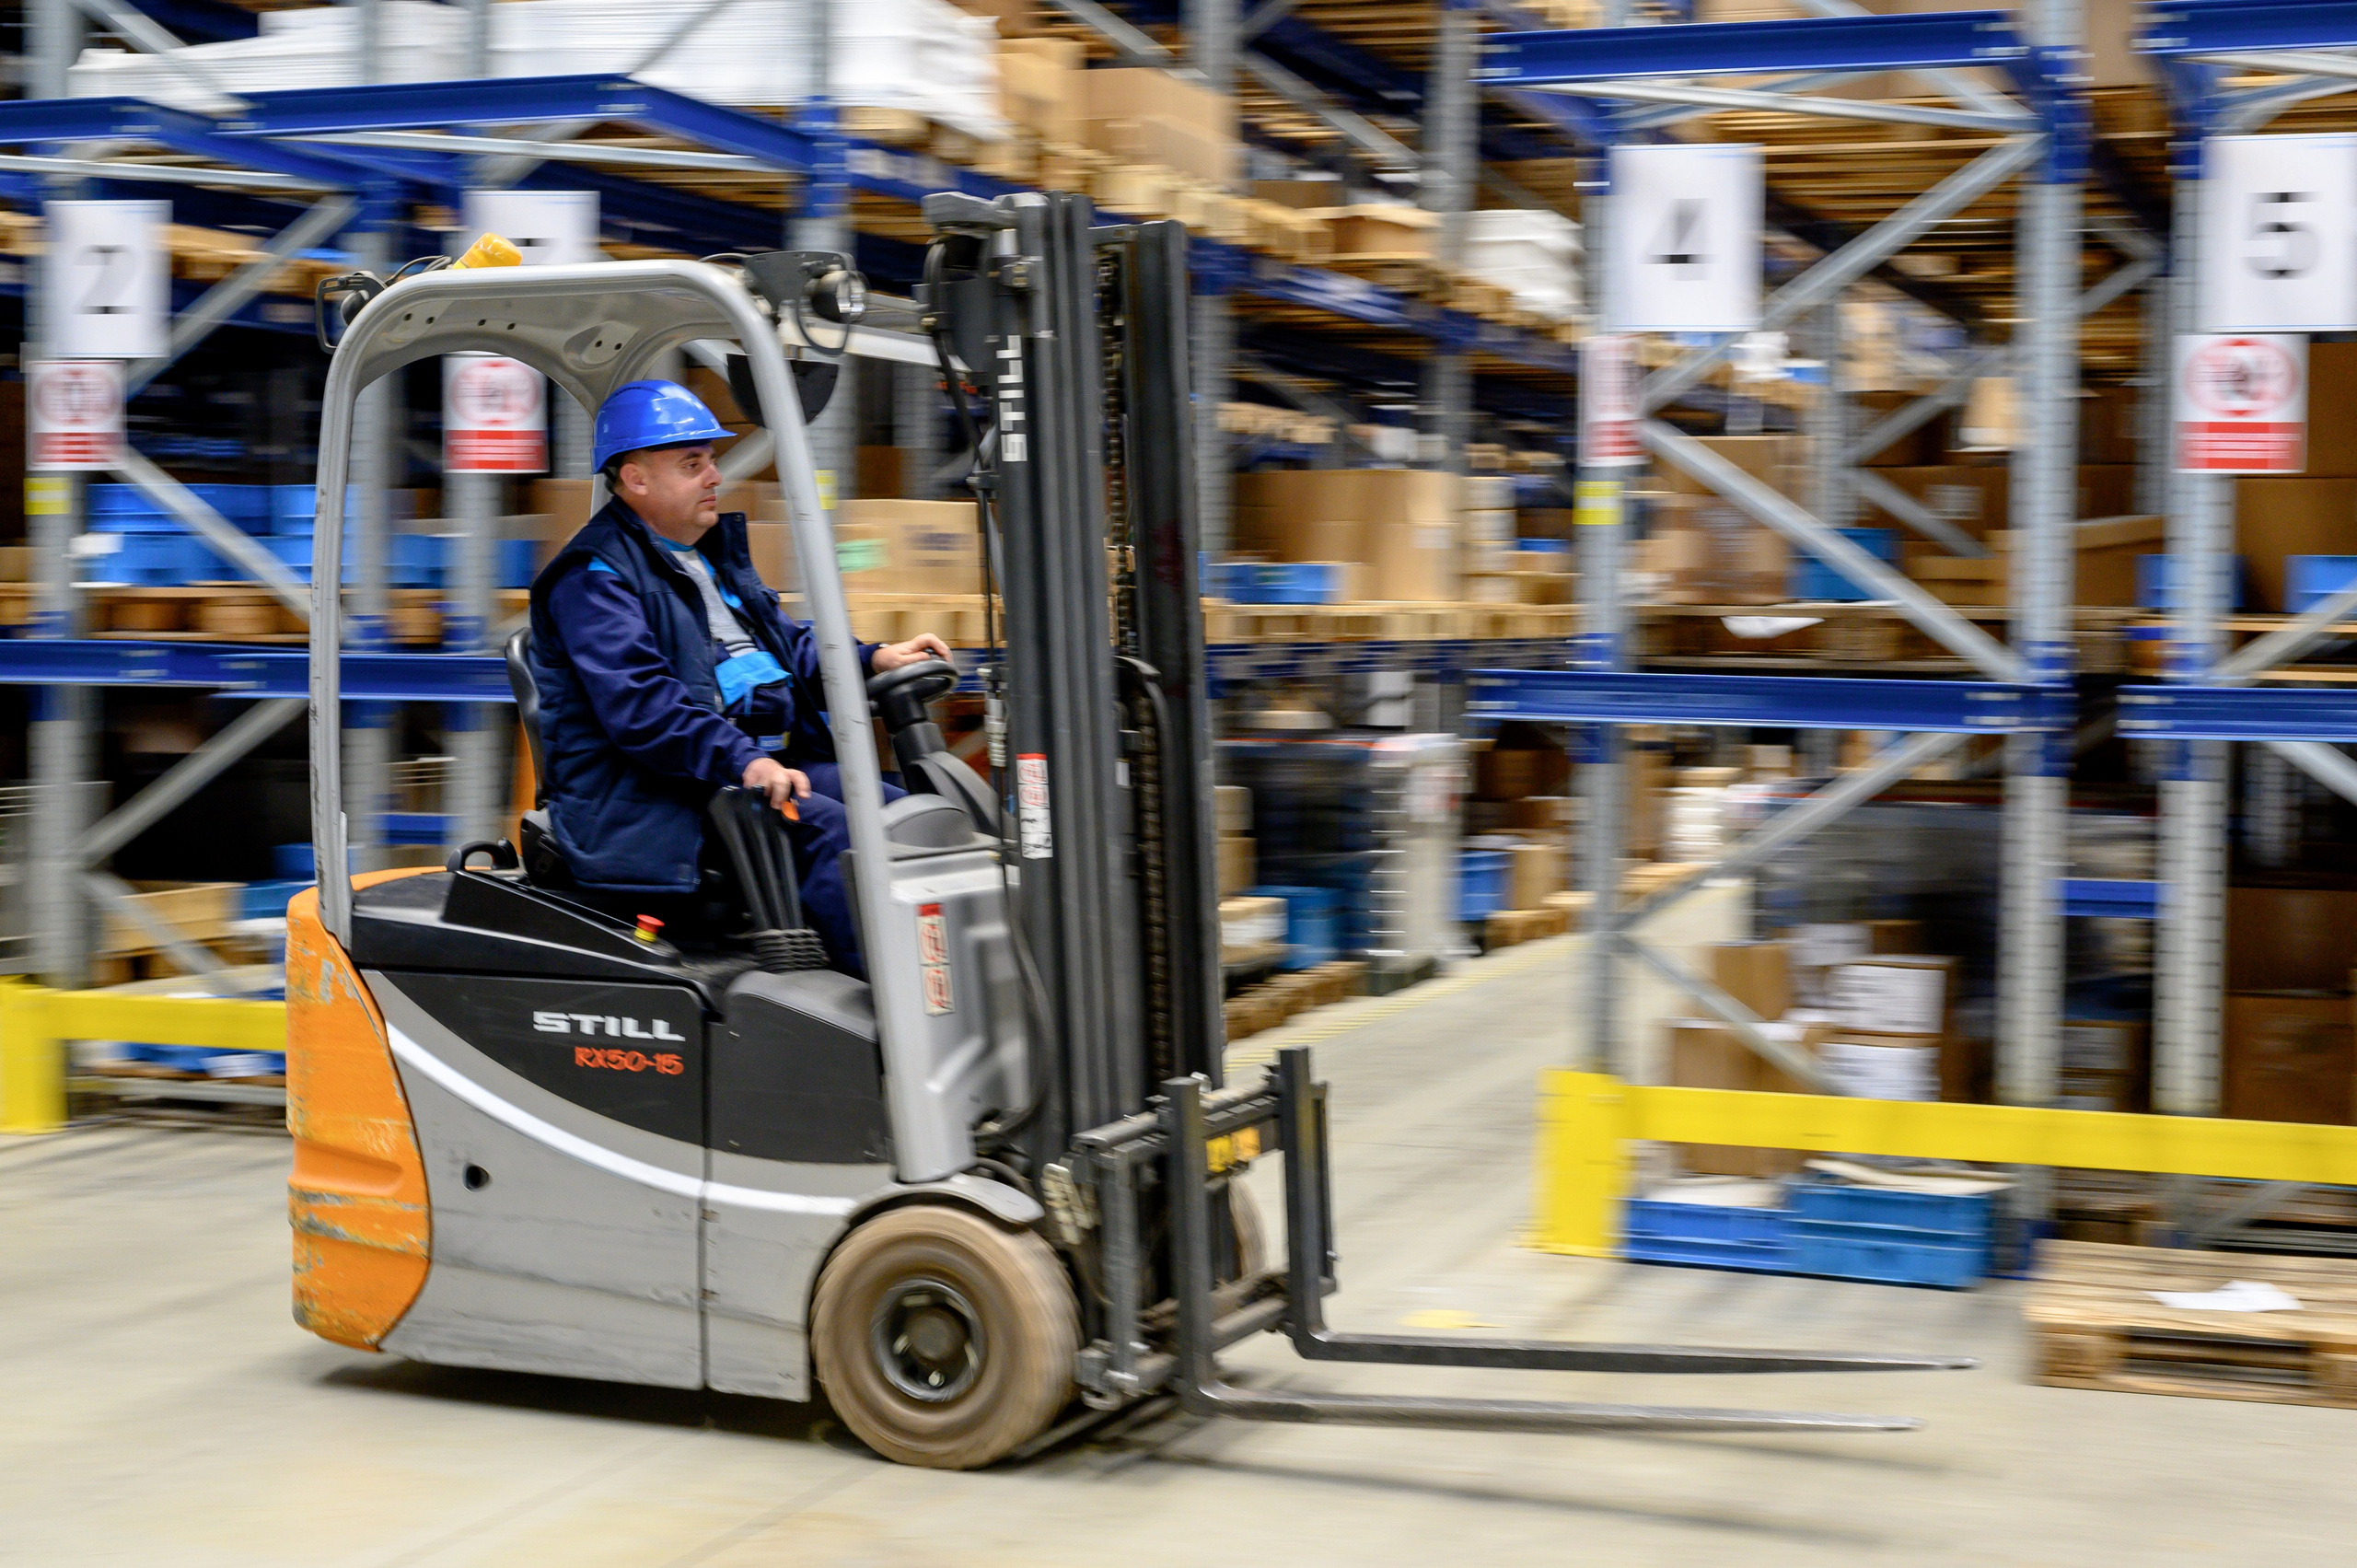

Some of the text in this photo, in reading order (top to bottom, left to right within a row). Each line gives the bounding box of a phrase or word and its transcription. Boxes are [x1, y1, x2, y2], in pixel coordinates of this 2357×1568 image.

[1642, 197, 1718, 281] 4
[2244, 192, 2321, 279] 5
[74, 244, 141, 315] 2
[996, 334, 1028, 462] STILL
[533, 1011, 686, 1041] STILL
